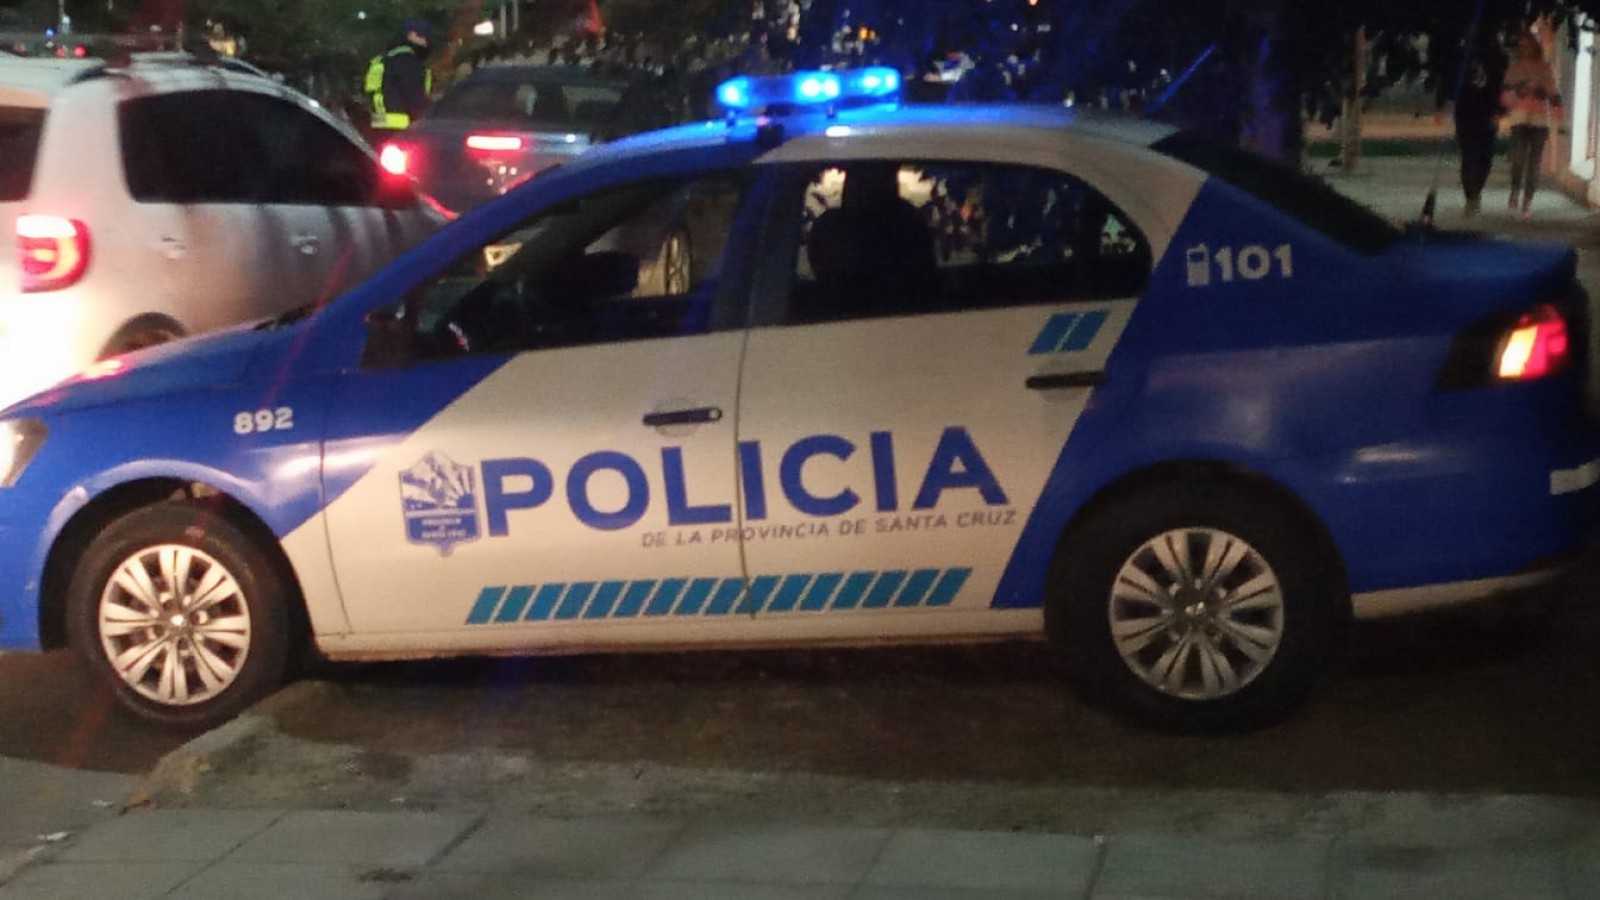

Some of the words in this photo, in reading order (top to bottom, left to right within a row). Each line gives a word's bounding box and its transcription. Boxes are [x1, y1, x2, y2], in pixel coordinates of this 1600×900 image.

[1214, 243, 1293, 281] 101
[233, 406, 294, 434] 892
[480, 426, 1010, 537] POLICIA
[641, 531, 667, 548] DE
[675, 530, 702, 546] LA
[711, 523, 830, 543] PROVINCIA
[839, 519, 866, 535] DE
[876, 514, 948, 533] SANTA
[956, 510, 1017, 528] CRUZ
